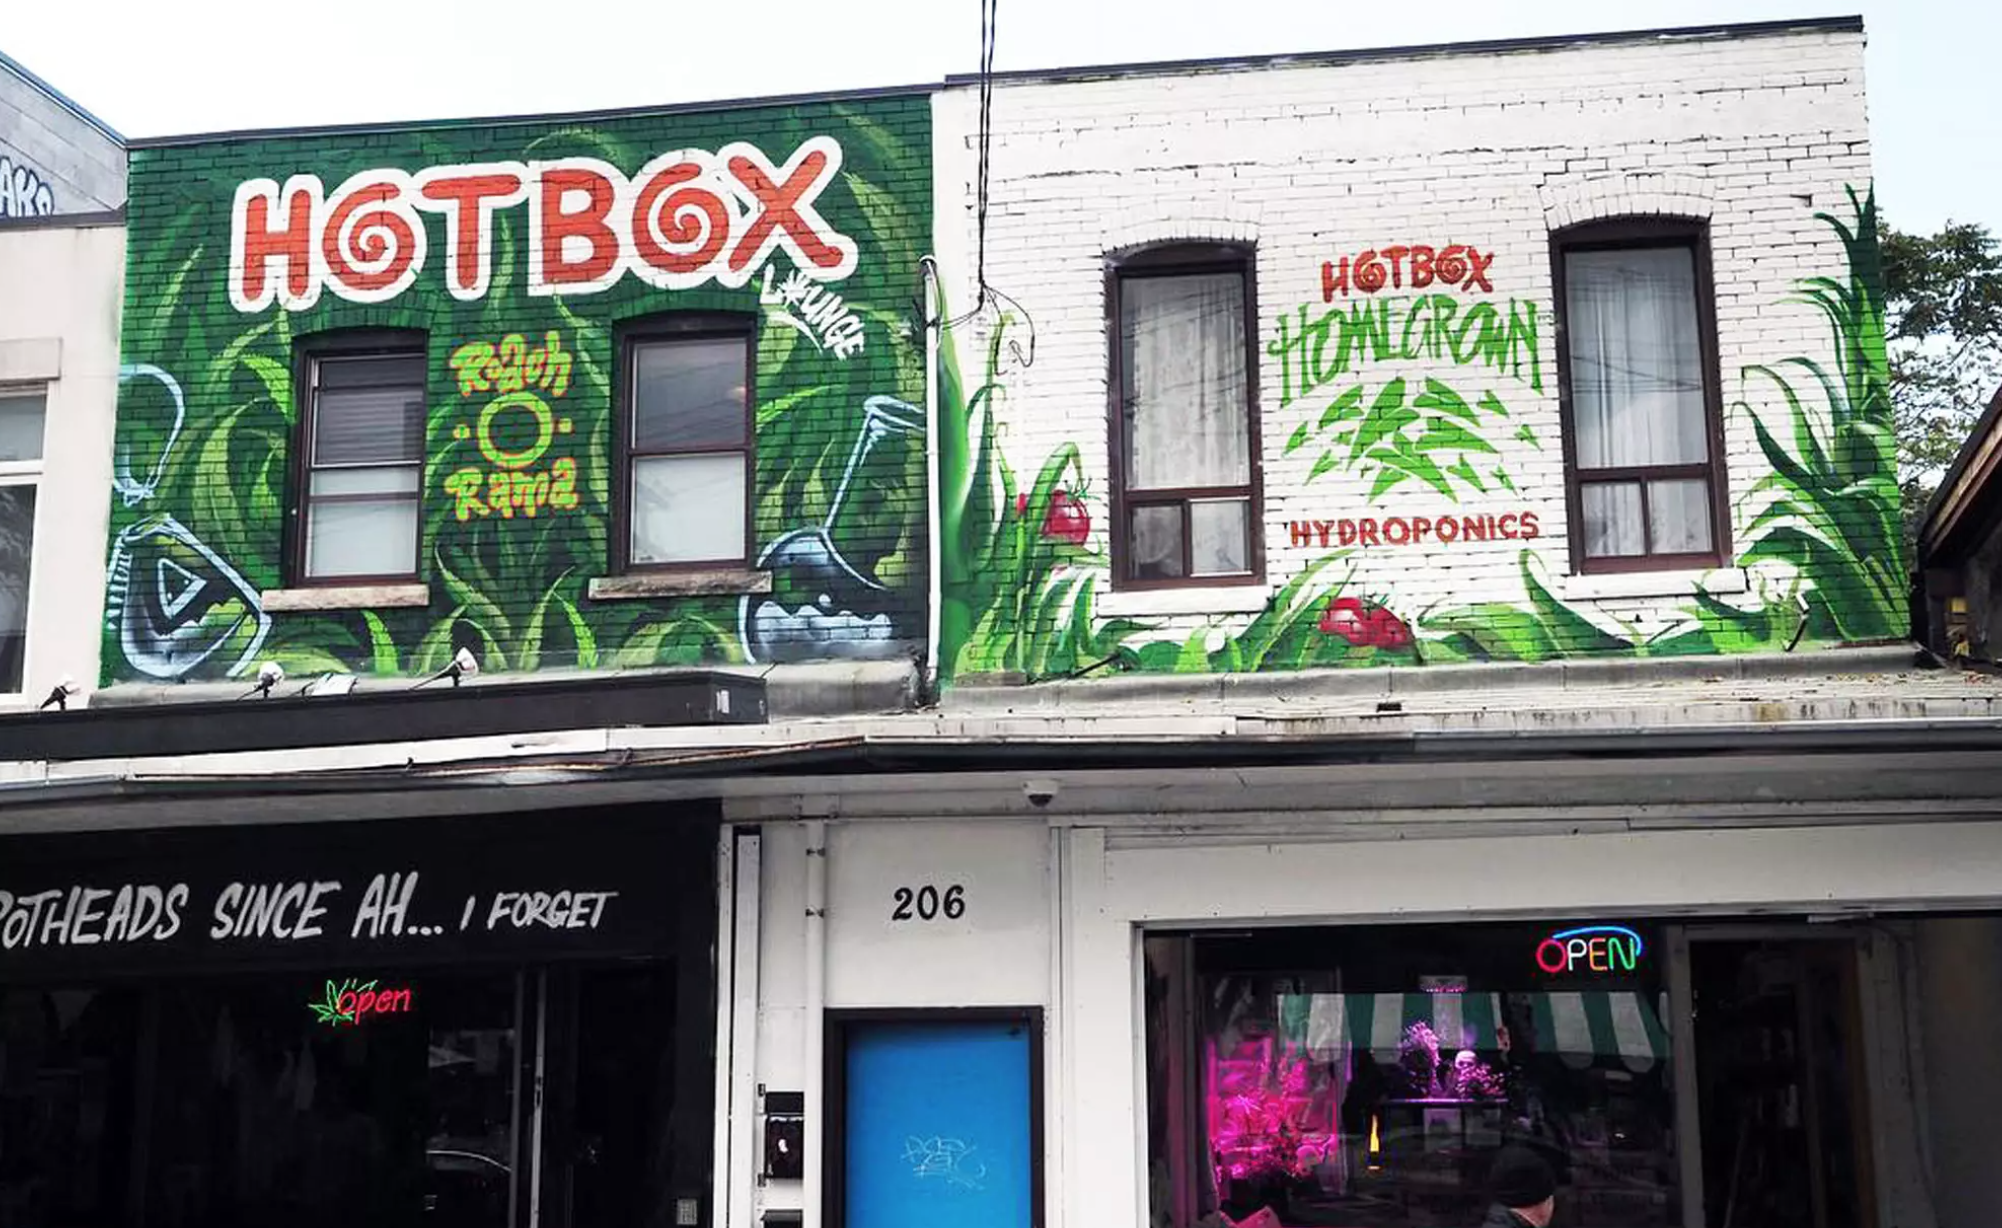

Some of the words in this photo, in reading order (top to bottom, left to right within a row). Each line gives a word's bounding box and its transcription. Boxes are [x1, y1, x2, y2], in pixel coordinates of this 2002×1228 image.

[228, 136, 858, 313] HOTBOX
[1322, 244, 1494, 303] HOTBOX
[1267, 294, 1544, 408] HOMEGROWN
[443, 457, 579, 521] Rama
[1290, 511, 1540, 548] HYDROPONICS
[210, 881, 341, 939] SINCE
[487, 891, 618, 930] FORGET
[892, 885, 966, 920] 206
[1536, 937, 1636, 973] OPEN
[338, 989, 411, 1025] open
